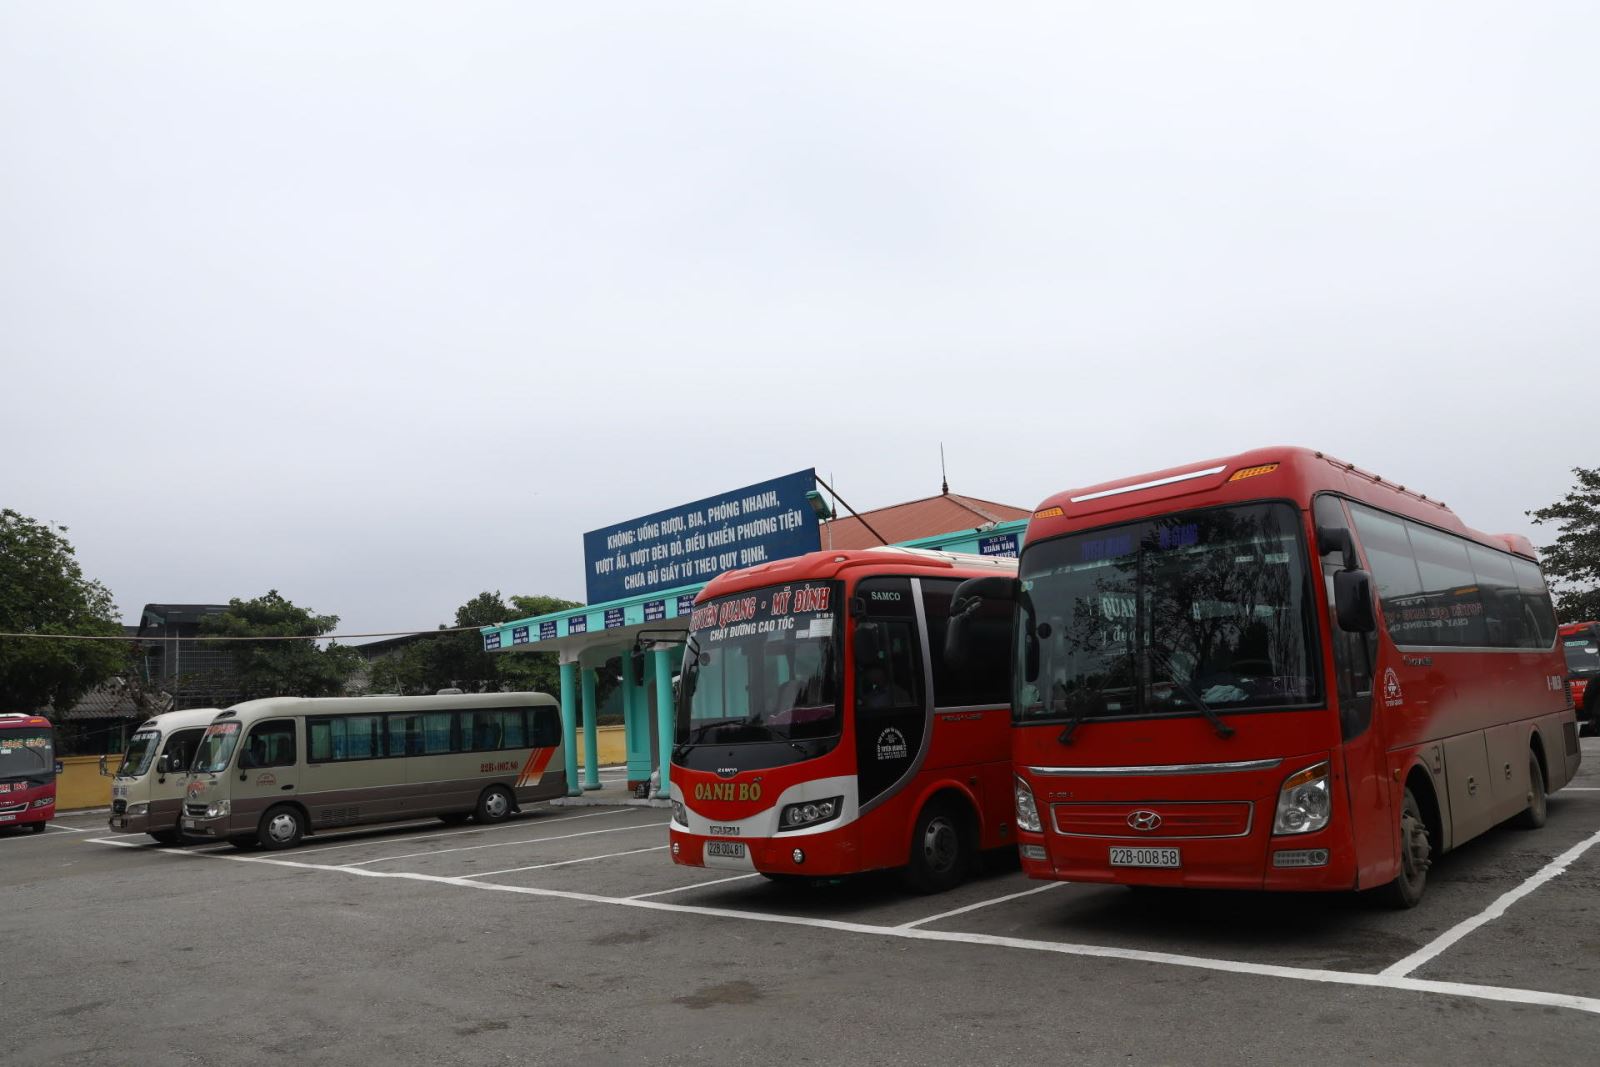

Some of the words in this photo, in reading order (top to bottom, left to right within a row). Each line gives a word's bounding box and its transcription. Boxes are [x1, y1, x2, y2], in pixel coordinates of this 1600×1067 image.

[607, 530, 637, 550] KHÔNG:
[637, 521, 659, 542] UỐNG
[661, 516, 687, 535] RƯỢU,
[688, 511, 707, 528] BIA,
[708, 501, 740, 523] PHÓNG
[742, 491, 780, 514] NHANH,
[595, 557, 614, 575] VƯỢT
[630, 548, 650, 567] VƯỢT
[652, 542, 668, 561] ĐÈN
[670, 535, 685, 556] ĐỎ,
[707, 522, 736, 548] KHIỂN
[738, 517, 778, 541] PHƯƠNG
[778, 508, 803, 531] TIỆN
[624, 571, 645, 590] CHƯA
[647, 564, 659, 585] ĐỦ
[661, 560, 680, 582] GIẤY
[695, 556, 718, 575] THEO
[719, 550, 737, 569] QUY
[741, 544, 768, 566] ĐỊNH.
[871, 591, 901, 601] SAMCO
[719, 596, 757, 629] QUANG
[771, 586, 792, 615] MỸ
[758, 620, 775, 633] CAO
[777, 616, 795, 631] TỐC
[695, 782, 735, 801] OANH
[709, 825, 740, 835] ISUZU
[1111, 849, 1177, 865] 22B-008.58
